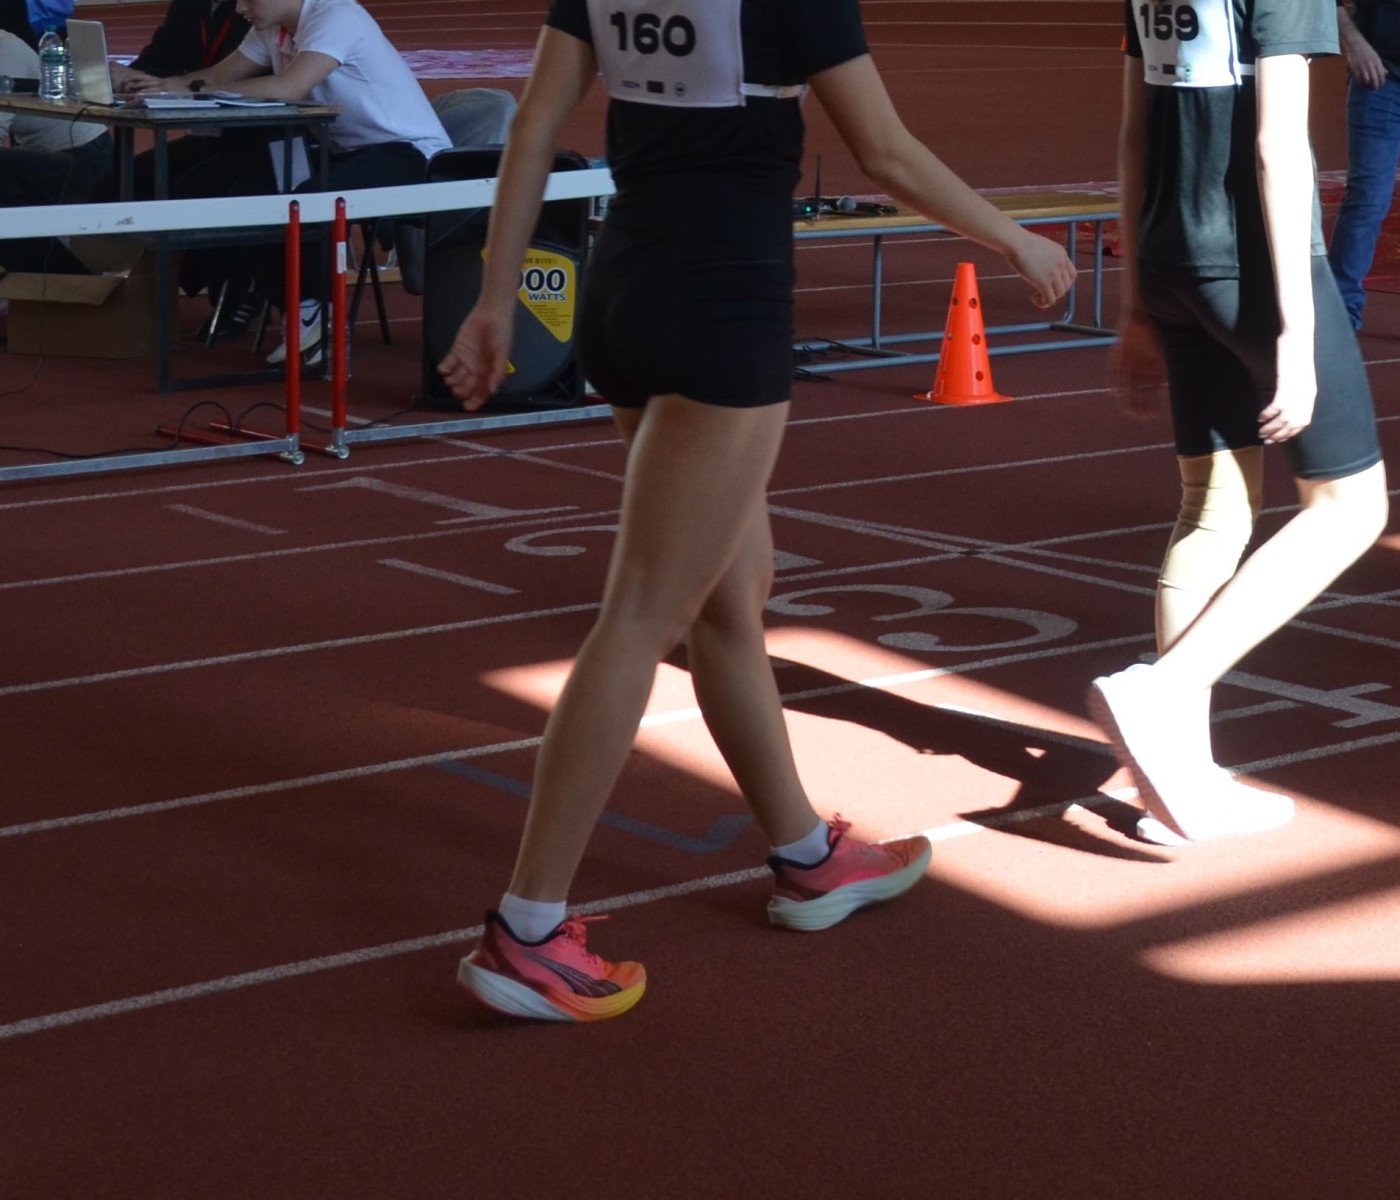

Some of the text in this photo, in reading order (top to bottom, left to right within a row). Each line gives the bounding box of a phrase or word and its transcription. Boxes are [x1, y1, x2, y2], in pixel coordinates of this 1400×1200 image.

[609, 11, 696, 57] 160
[1139, 3, 1199, 41] 159
[519, 268, 566, 292] 00
[527, 293, 566, 302] WATTS
[766, 583, 1079, 653] 3
